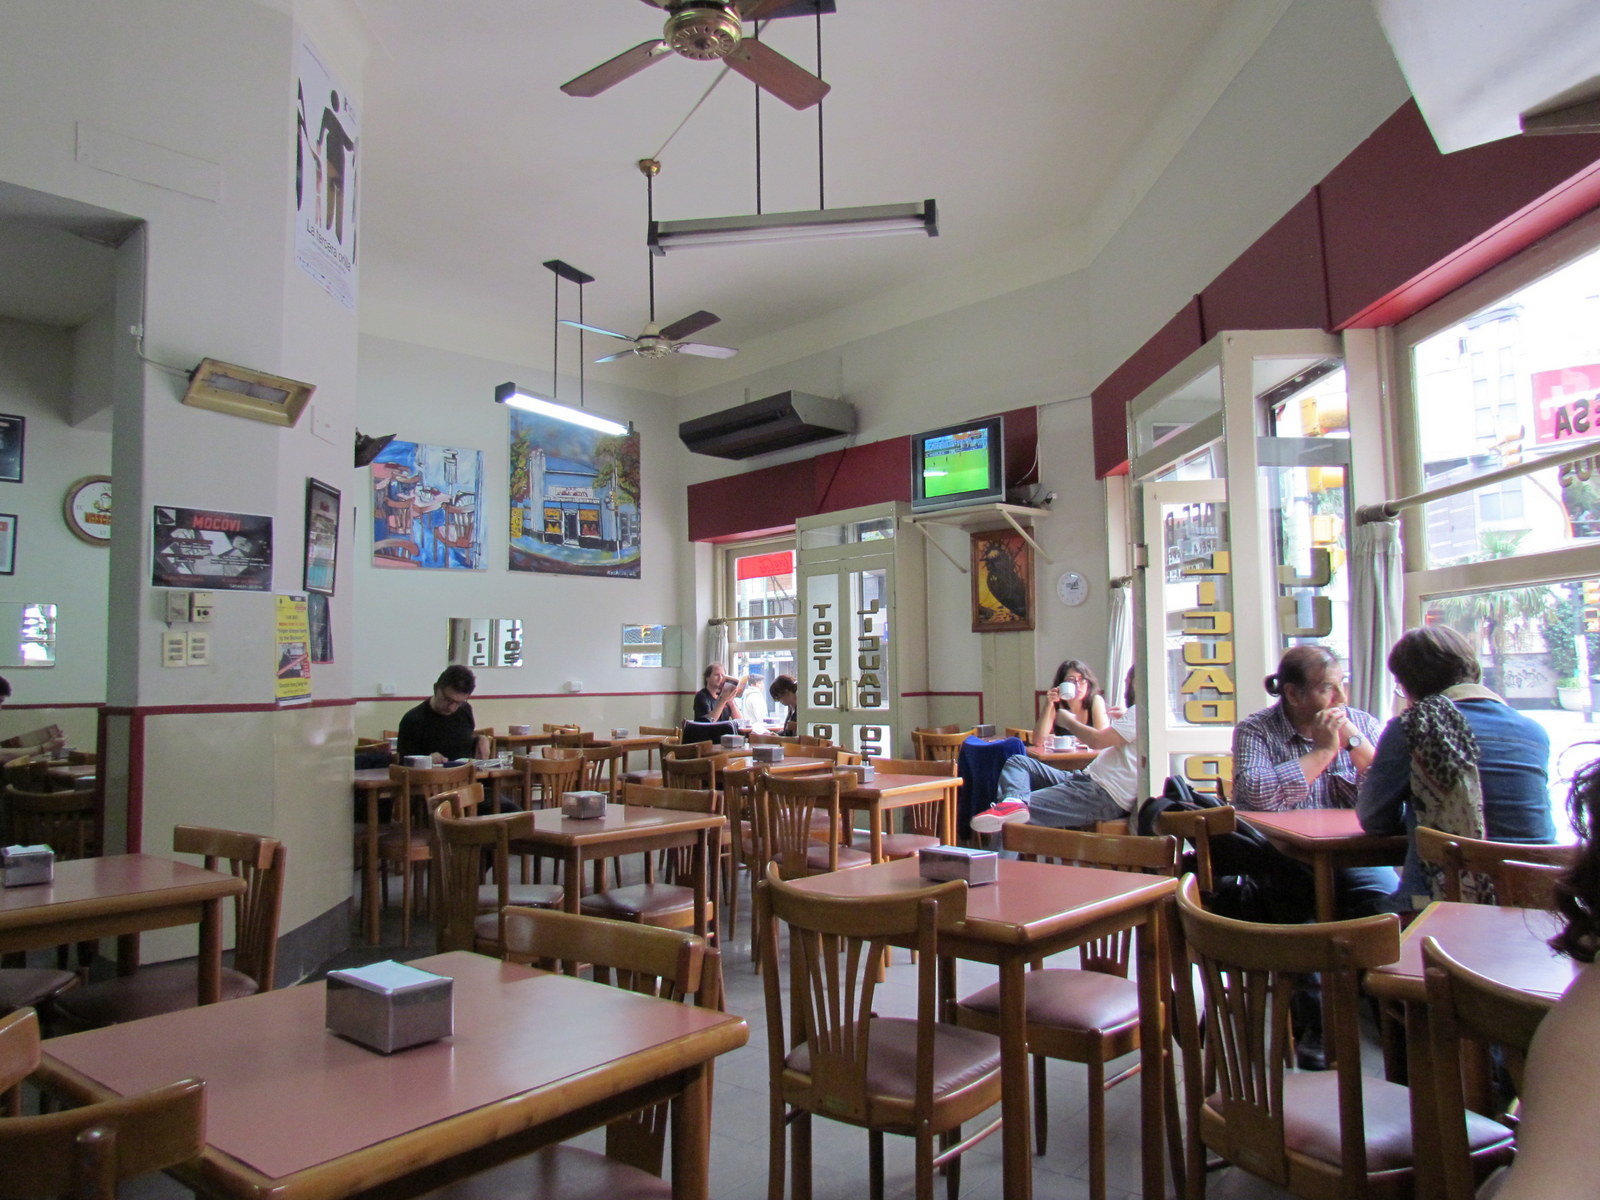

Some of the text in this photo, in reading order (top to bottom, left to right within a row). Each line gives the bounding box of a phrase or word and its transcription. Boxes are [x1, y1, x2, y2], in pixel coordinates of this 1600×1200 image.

[306, 218, 315, 237] La
[315, 228, 338, 259] tercera
[192, 514, 241, 532] MOCOVI
